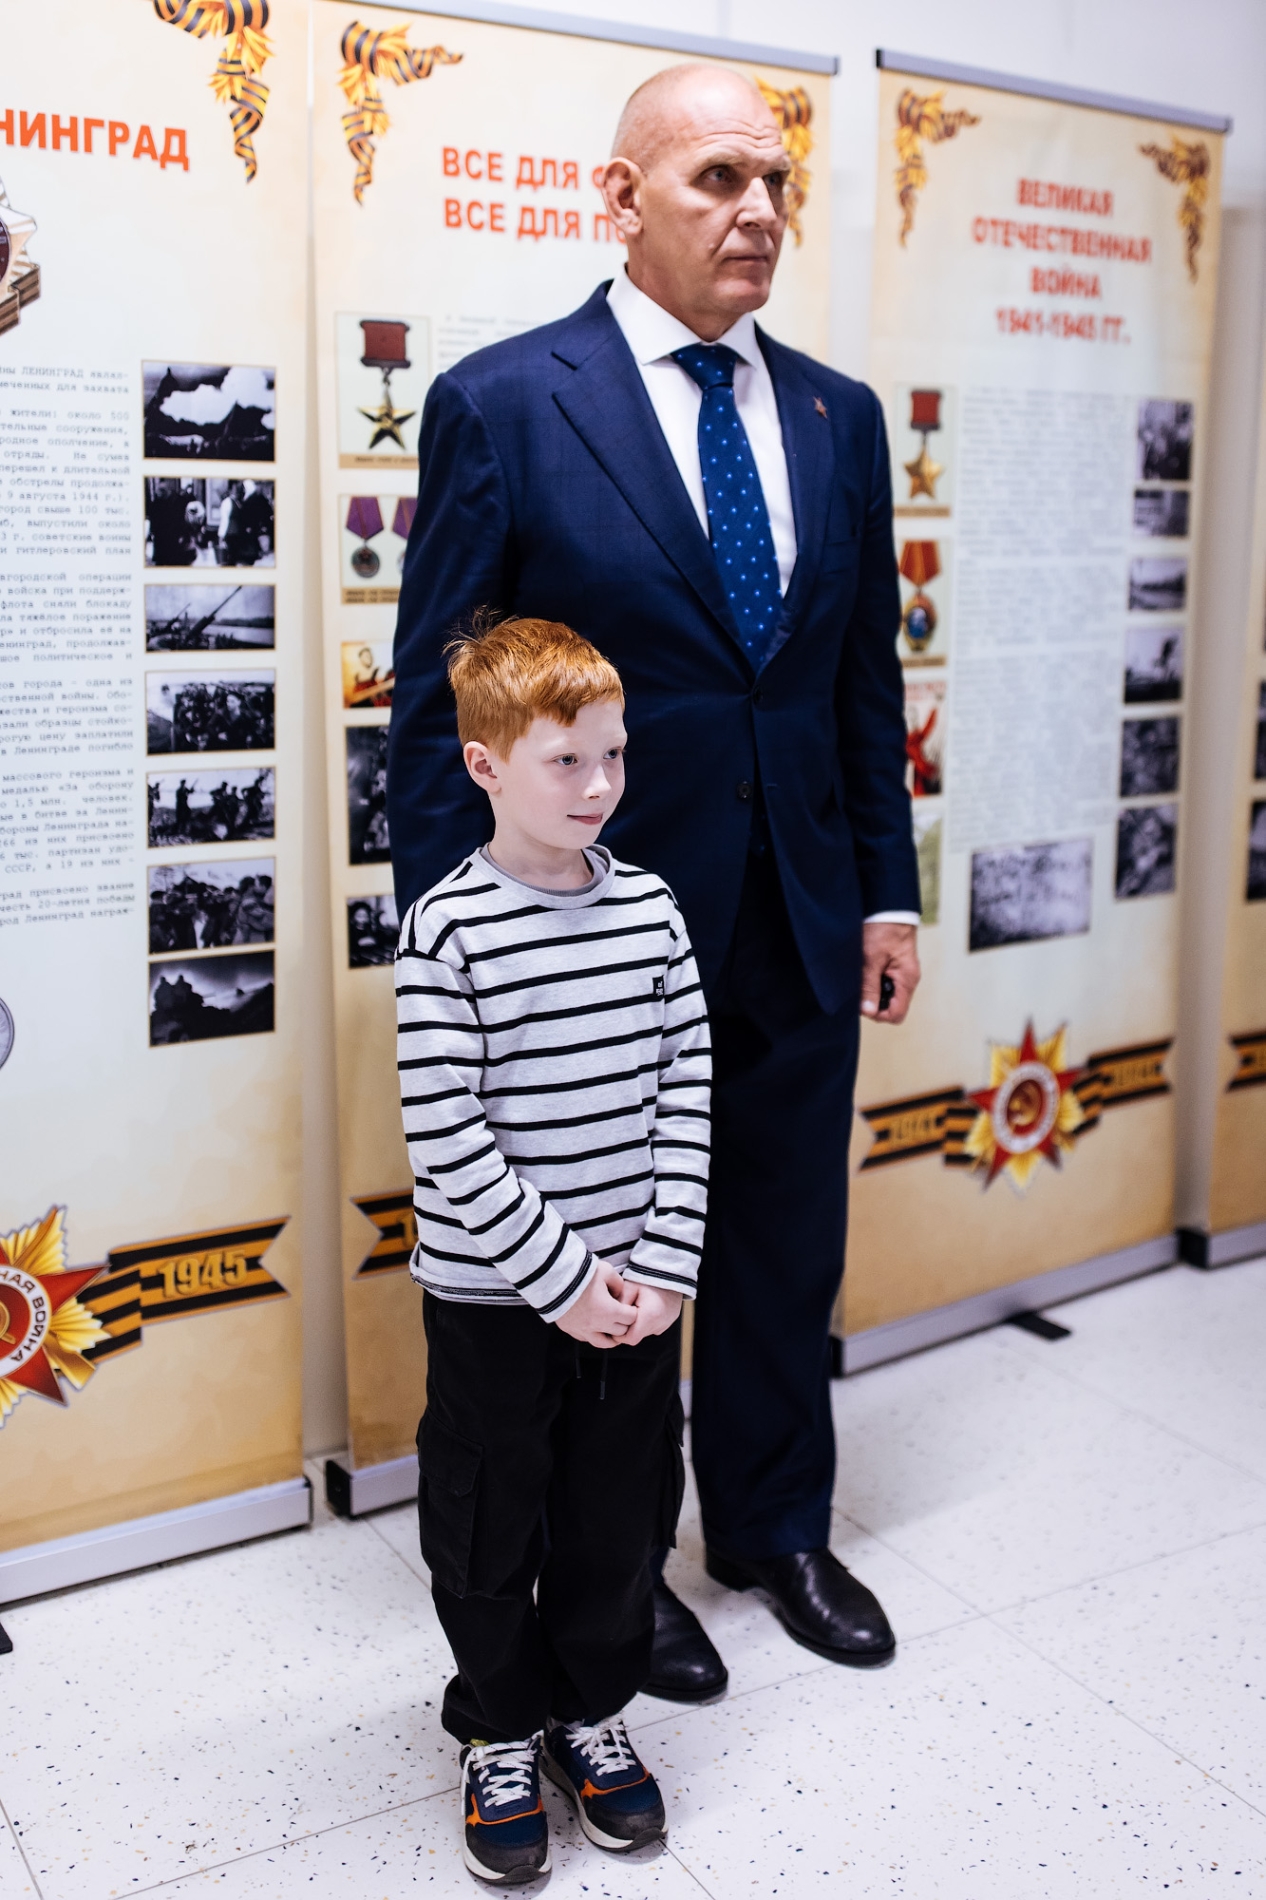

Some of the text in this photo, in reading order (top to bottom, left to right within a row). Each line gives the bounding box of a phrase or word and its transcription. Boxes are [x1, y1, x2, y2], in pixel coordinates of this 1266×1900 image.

[442, 147, 503, 181] ВСЕ
[516, 156, 579, 190] ДЛЯ
[1017, 178, 1113, 216] ВЕЛИКАЯ
[445, 198, 506, 232] ВСЕ
[517, 207, 580, 240] ДЛЯ
[973, 216, 1152, 263] ОТЕЧЕСТВЕННАЯ
[1030, 263, 1101, 299] ВОЙНА
[22, 367, 84, 378] ЛЕНИНГРАД
[158, 1250, 248, 1299] 1945
